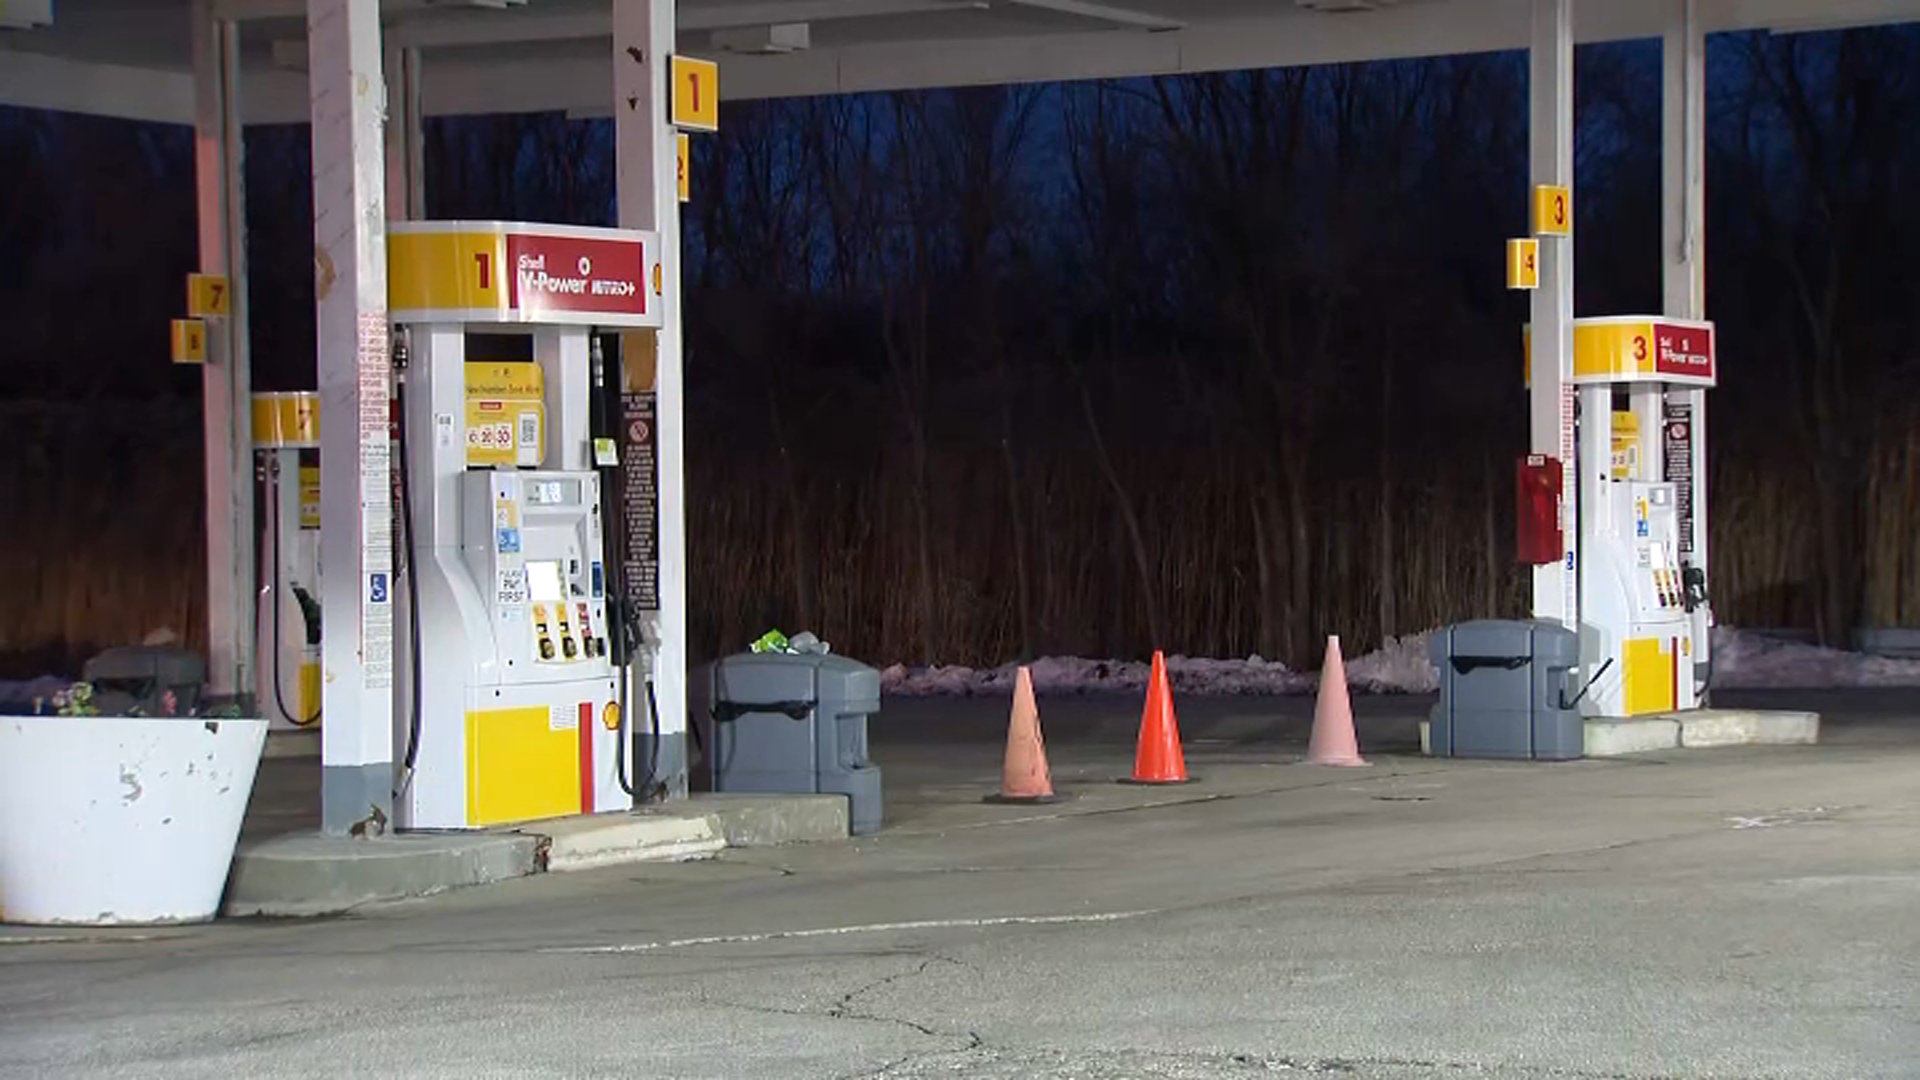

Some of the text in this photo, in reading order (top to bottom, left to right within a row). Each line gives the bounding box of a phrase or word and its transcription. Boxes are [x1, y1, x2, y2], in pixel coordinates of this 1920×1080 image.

[688, 73, 699, 112] 1
[1554, 195, 1564, 225] 3
[474, 253, 489, 289] 1
[519, 254, 545, 270] Shell
[520, 270, 588, 294] V-Power
[211, 284, 224, 309] 7
[1633, 335, 1647, 362] 3
[298, 409, 312, 430] 7
